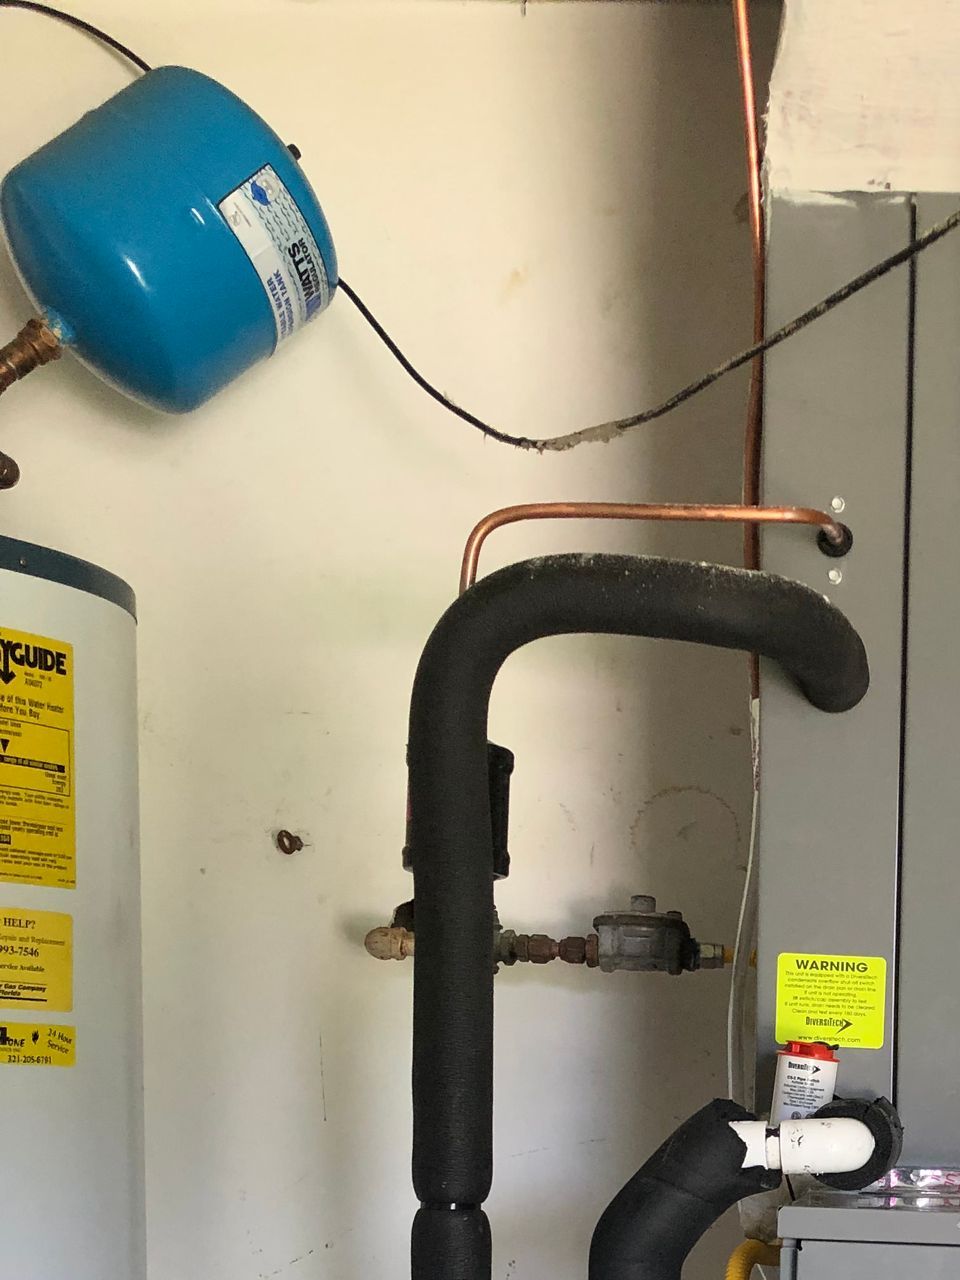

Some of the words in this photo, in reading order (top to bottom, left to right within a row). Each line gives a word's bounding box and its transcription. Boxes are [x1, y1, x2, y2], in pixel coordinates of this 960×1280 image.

[288, 243, 314, 302] WATTS
[298, 238, 320, 293] REGULATOR
[273, 269, 287, 297] TANK
[267, 277, 282, 311] WATER
[15, 706, 27, 716] You
[29, 708, 40, 720] Buy
[4, 917, 36, 929] HELP?
[31, 937, 65, 946] Replacement
[20, 964, 45, 972] Available
[795, 959, 868, 972] WARNING
[18, 984, 47, 992] Company
[48, 1028, 57, 1037] 24
[58, 1031, 72, 1044] Hour
[48, 1039, 69, 1054] Service
